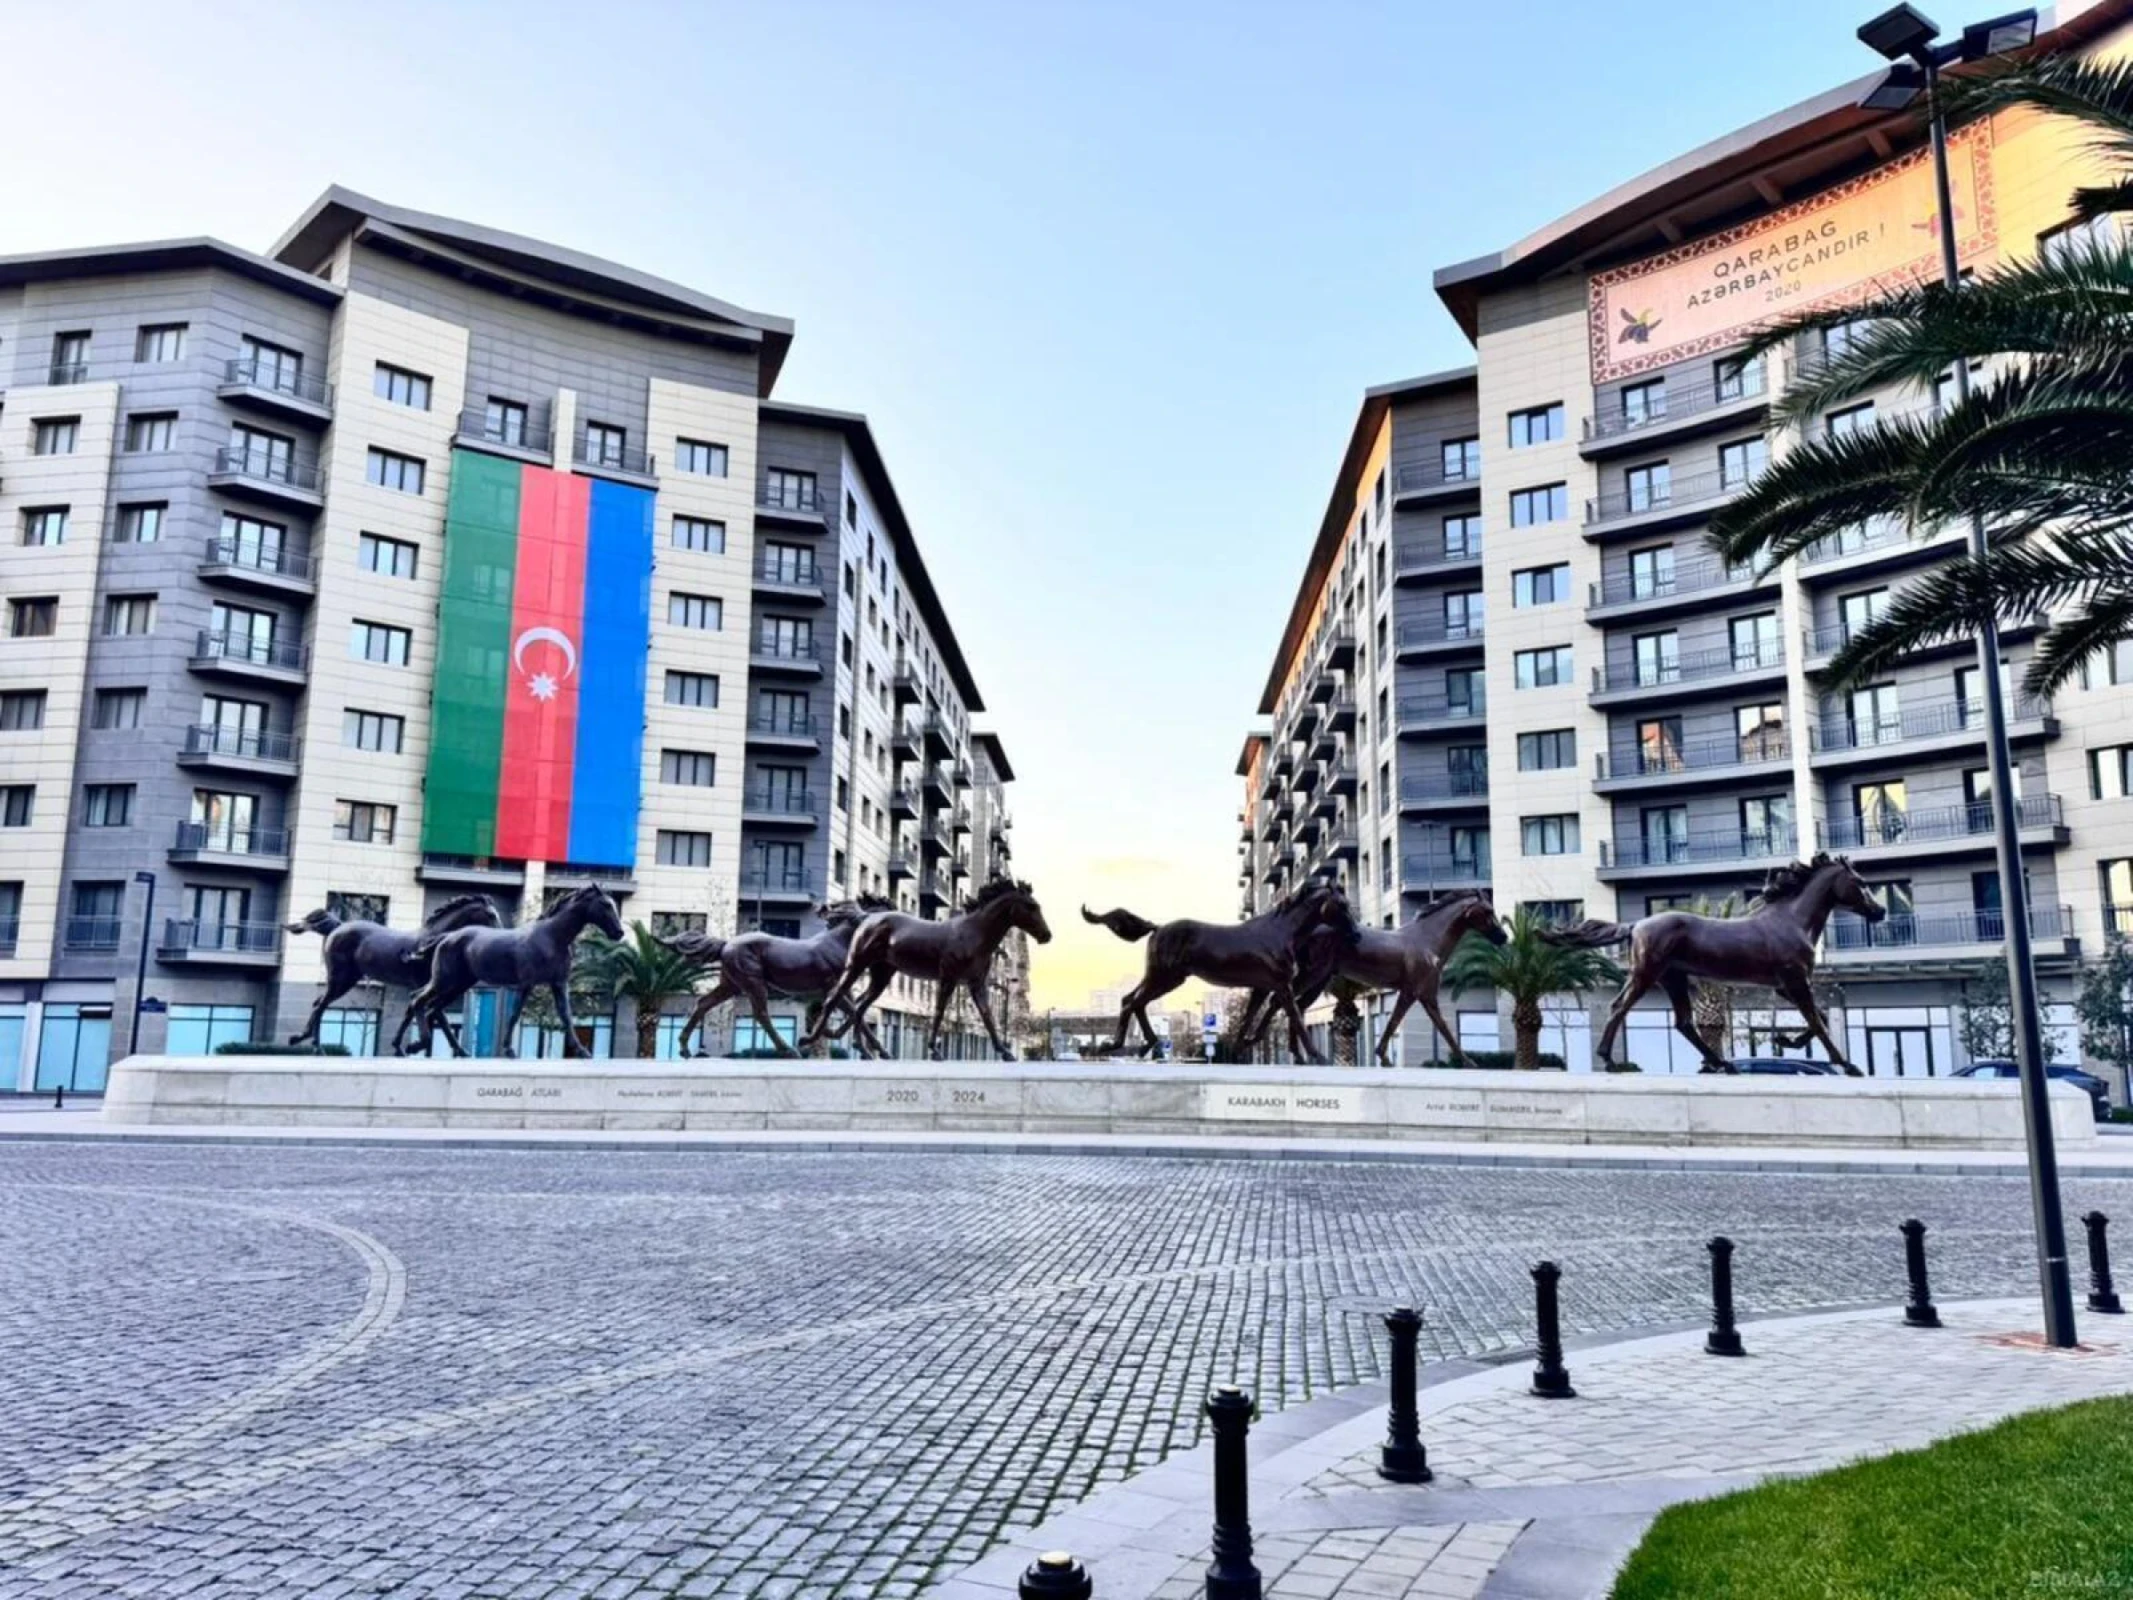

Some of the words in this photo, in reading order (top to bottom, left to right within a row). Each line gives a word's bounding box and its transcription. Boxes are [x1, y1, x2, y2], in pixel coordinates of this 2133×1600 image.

[1765, 279, 1802, 303] 2020
[887, 1090, 919, 1102] 2020
[953, 1090, 985, 1103] 2024
[1227, 1096, 1286, 1109] KARABAKH
[1296, 1098, 1341, 1110] HORSES
